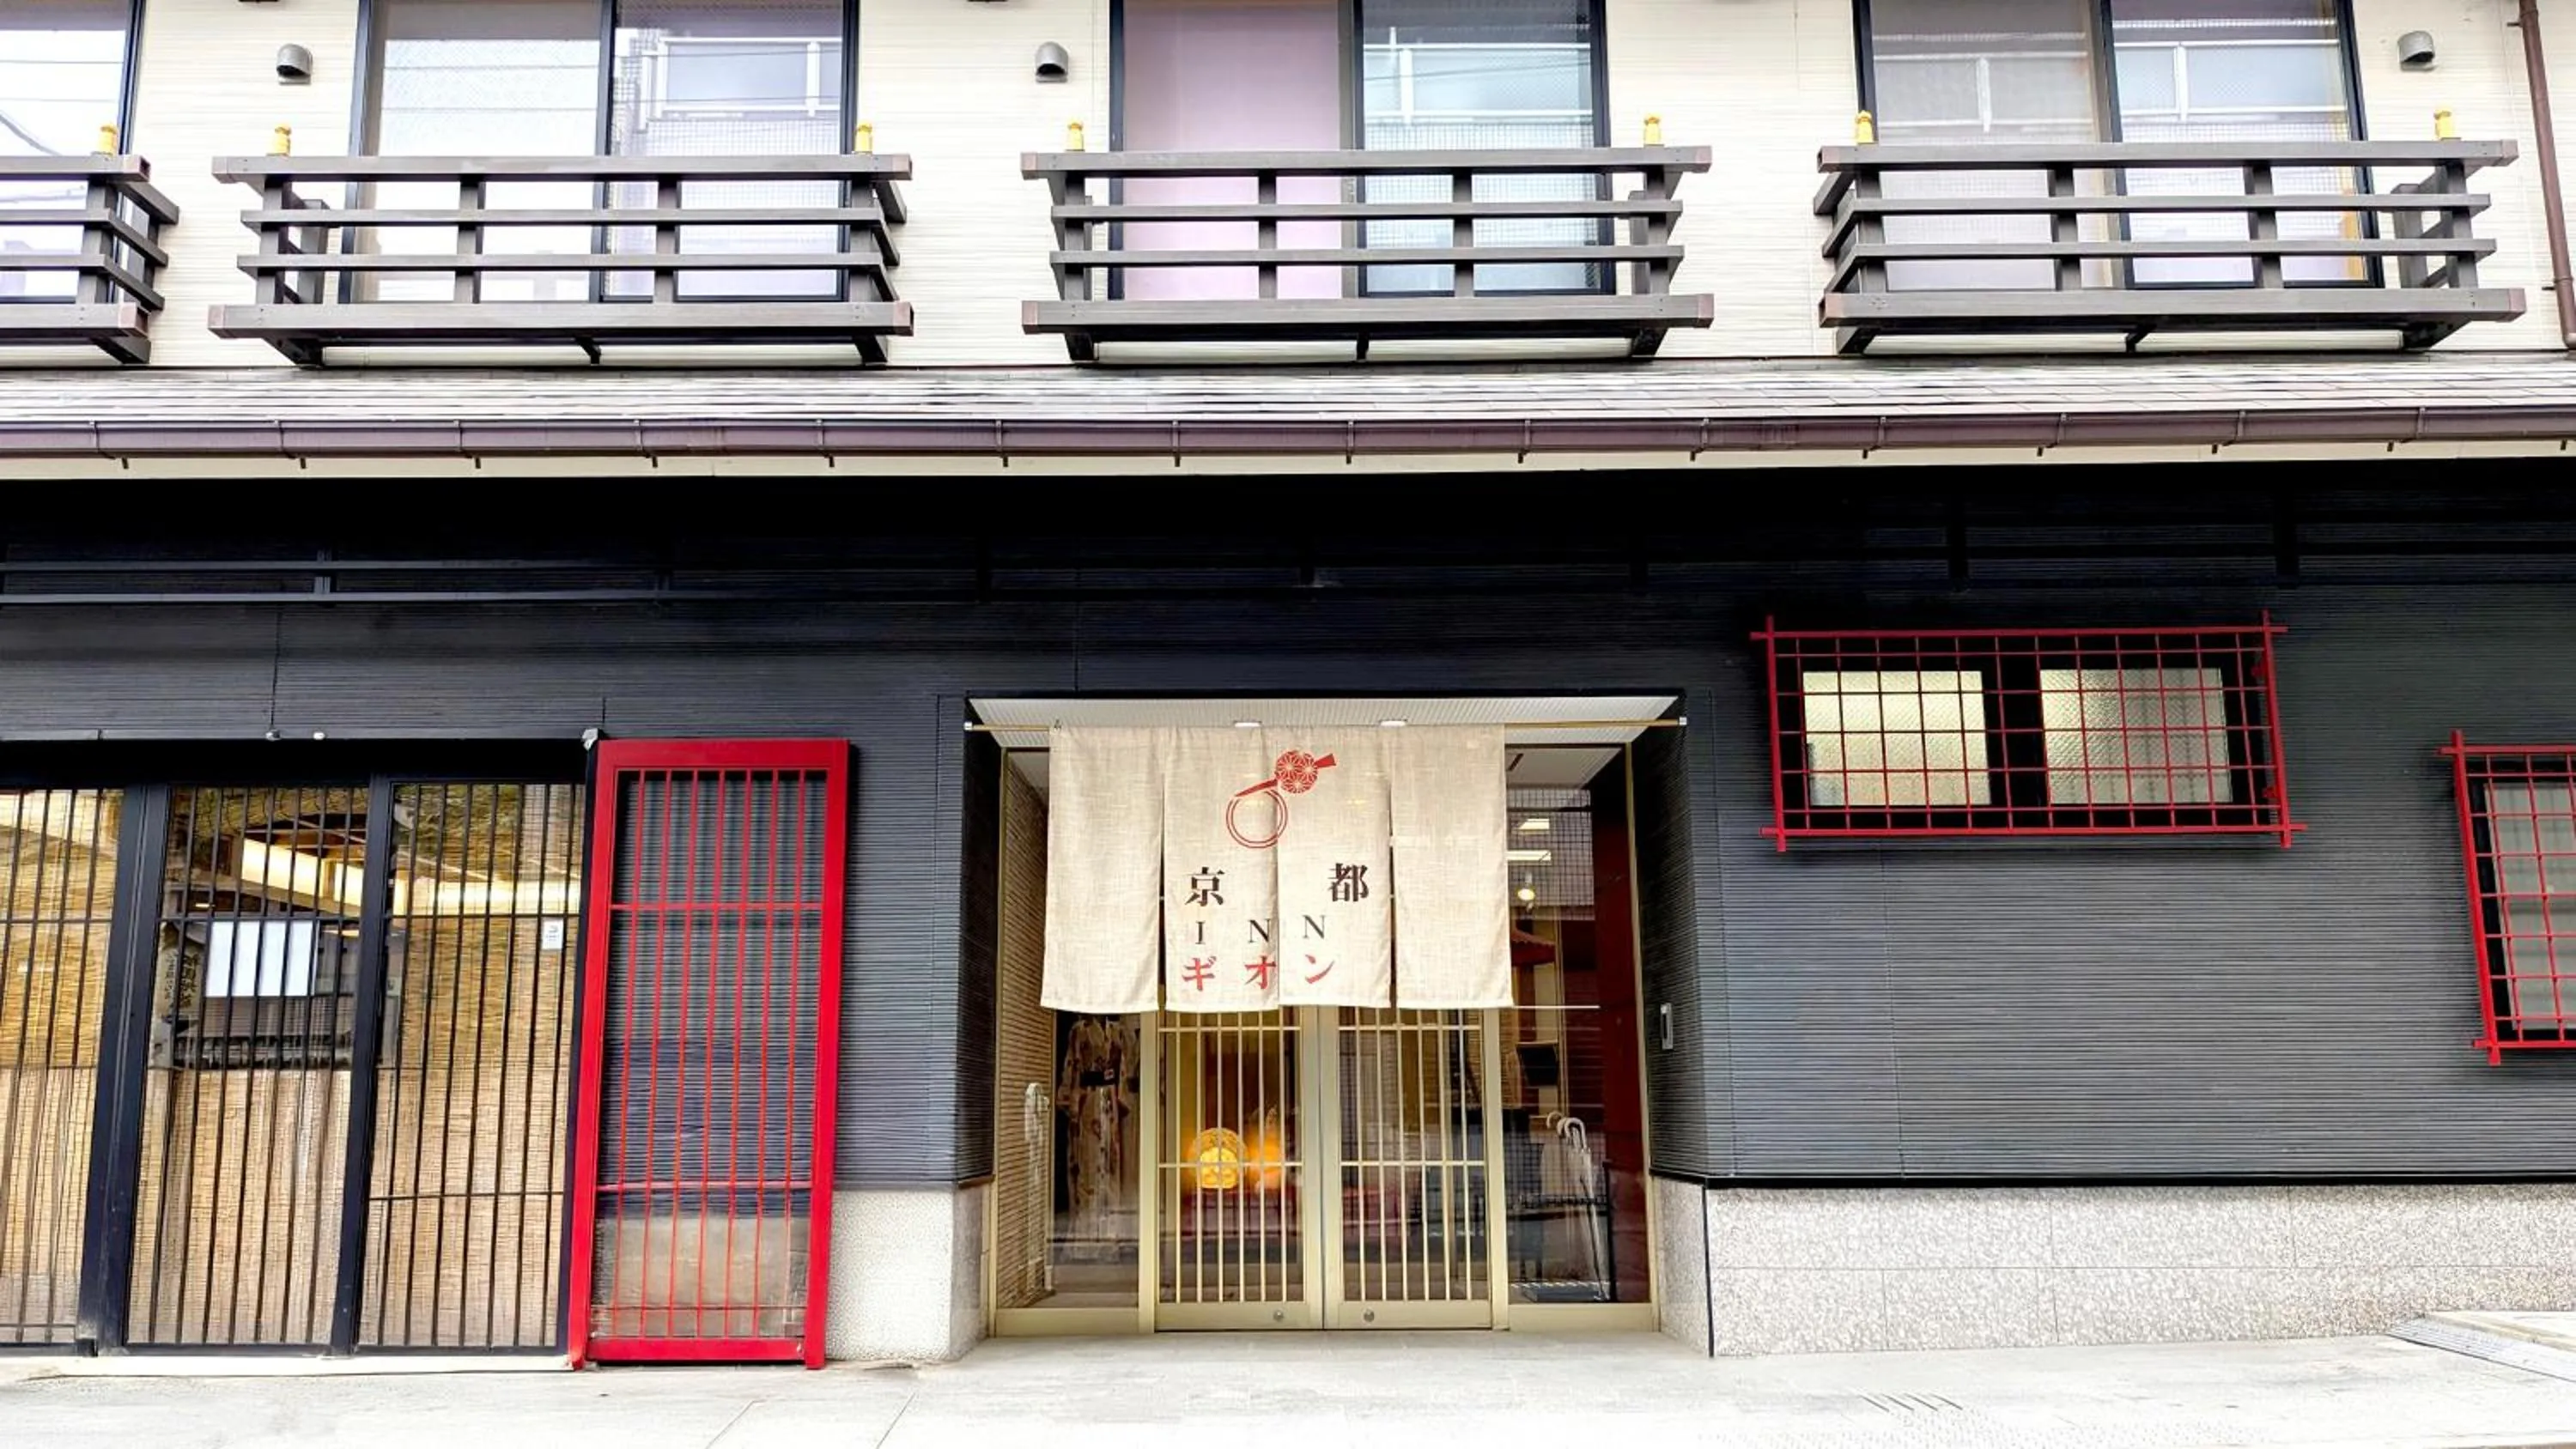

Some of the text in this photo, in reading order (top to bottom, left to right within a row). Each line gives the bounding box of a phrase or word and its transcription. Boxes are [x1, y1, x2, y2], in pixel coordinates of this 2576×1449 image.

[1185, 864, 1370, 906] 京都
[1195, 915, 1326, 945] INN
[1182, 955, 1334, 991] ギオン
